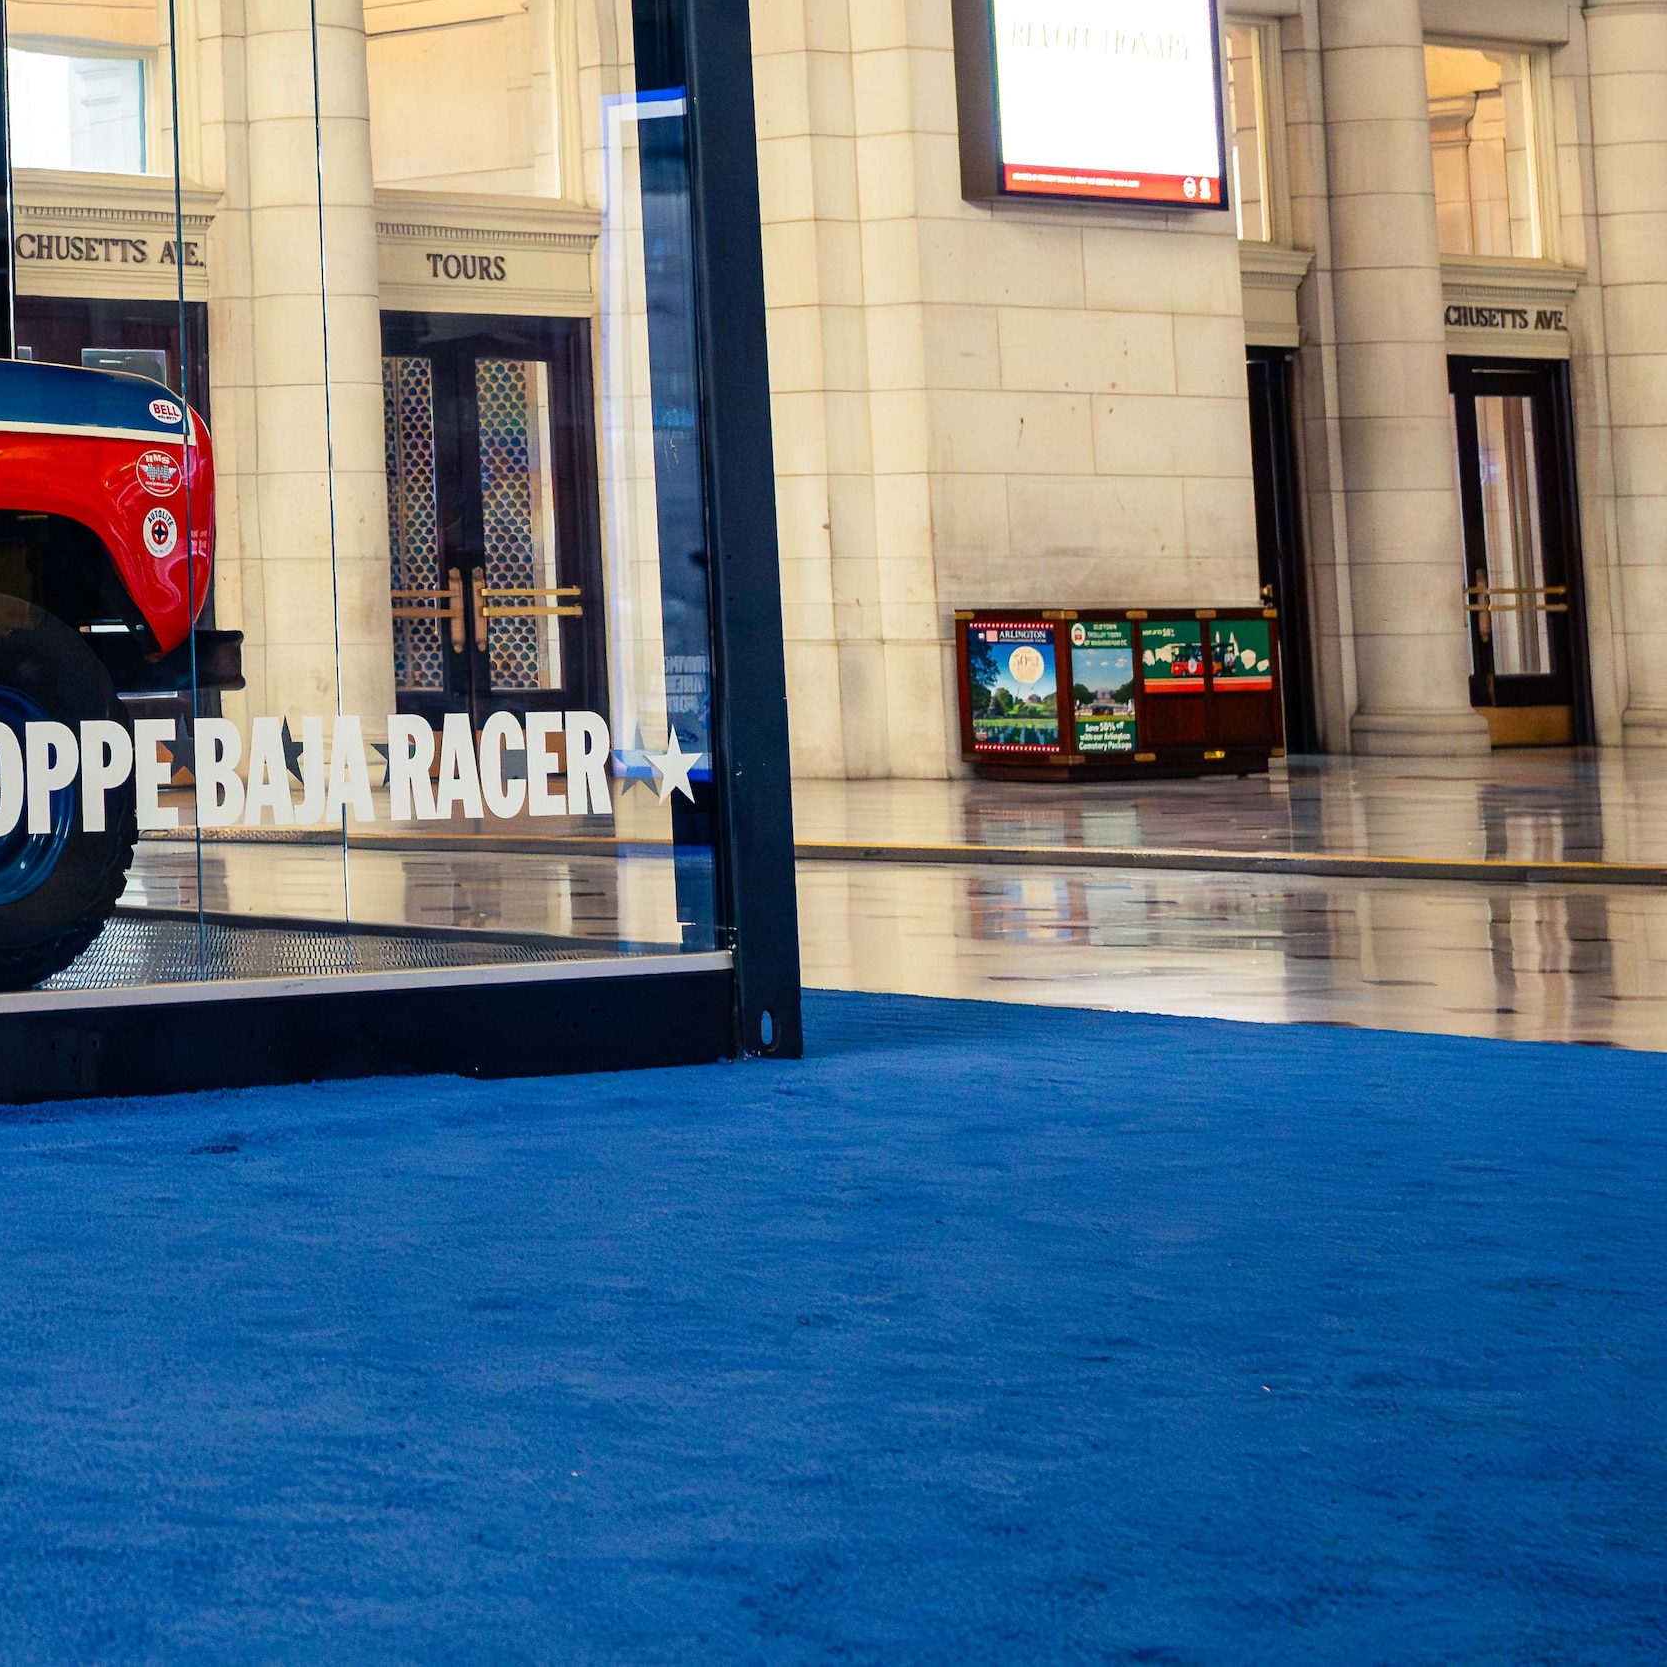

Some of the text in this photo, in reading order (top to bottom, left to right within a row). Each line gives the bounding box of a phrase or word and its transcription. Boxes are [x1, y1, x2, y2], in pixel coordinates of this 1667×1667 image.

[16, 233, 147, 264] CHUSETTS
[426, 253, 506, 280] TOURS
[153, 403, 180, 417] BELL
[147, 509, 174, 528] AUTOLITE
[999, 630, 1046, 639] ARLINGTON
[193, 713, 376, 828] BAJA
[387, 711, 613, 821] RACER
